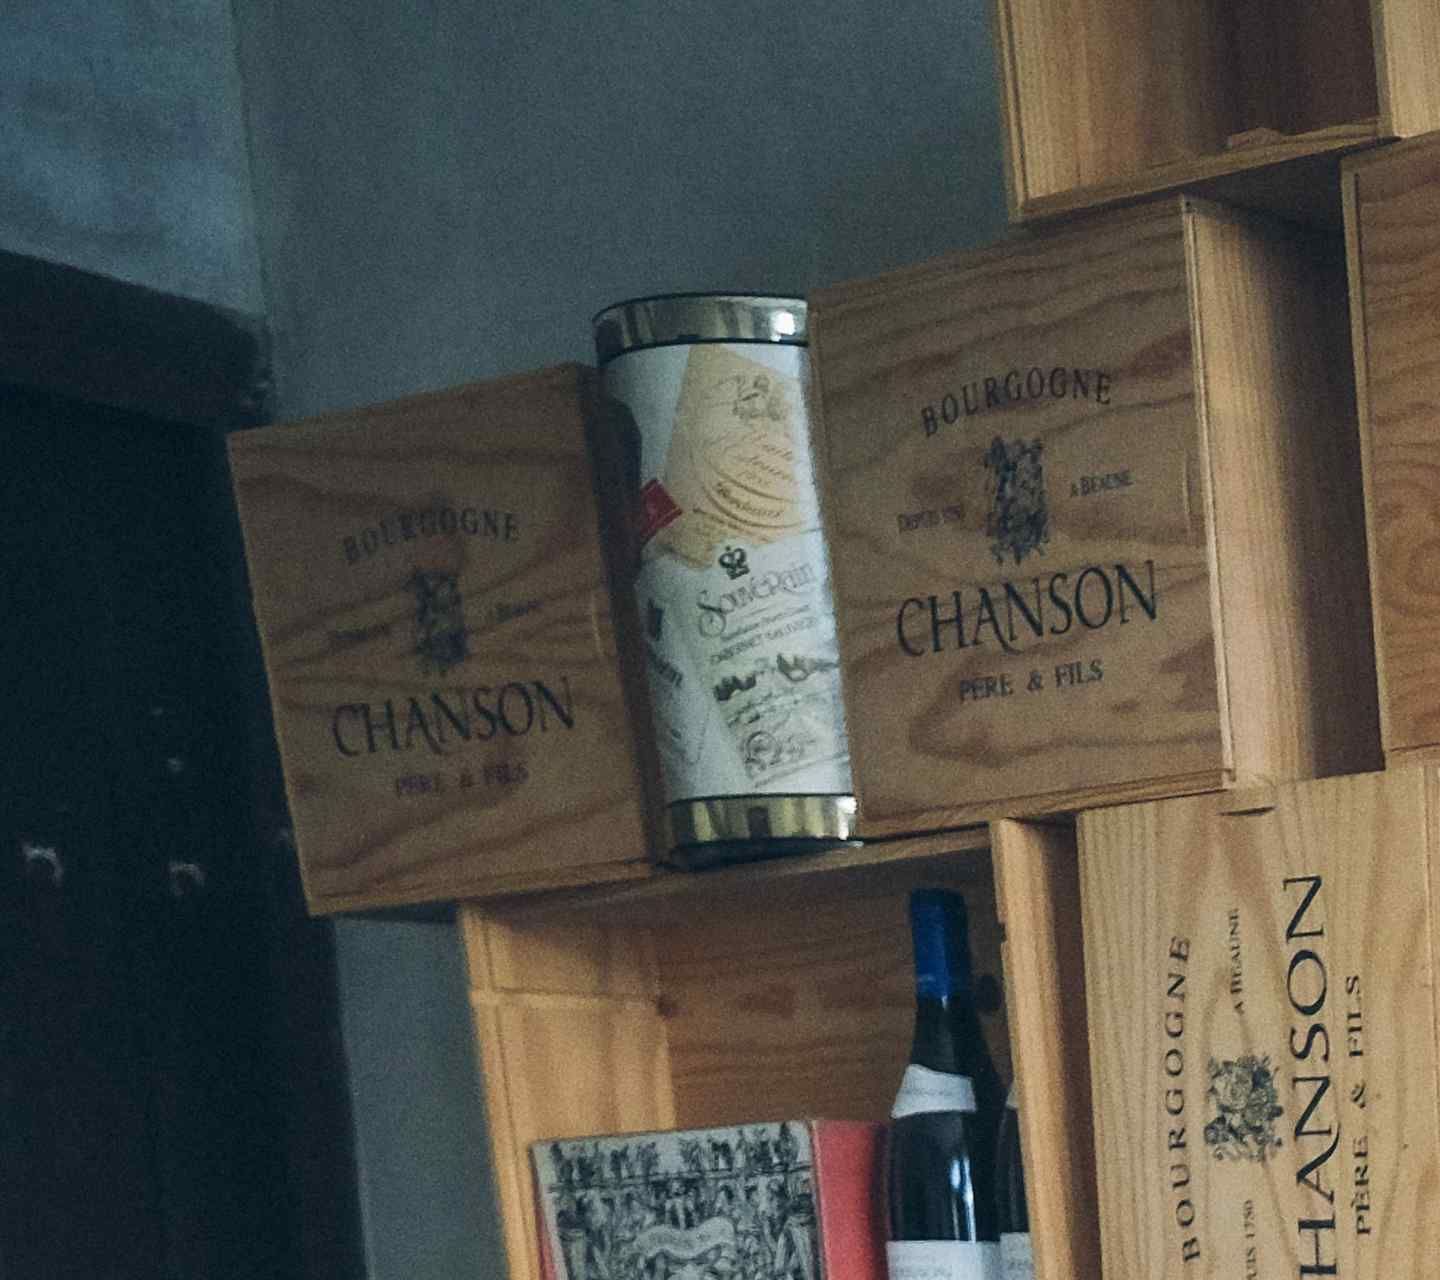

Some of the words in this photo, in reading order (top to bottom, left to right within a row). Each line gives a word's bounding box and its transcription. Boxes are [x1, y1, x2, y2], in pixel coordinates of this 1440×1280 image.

[920, 368, 1113, 438] BOURGOGNE
[895, 560, 1160, 658] CHANSON
[1054, 658, 1105, 688] FILS
[332, 678, 577, 758] CHANSON
[1346, 974, 1364, 1058] FILS
[1164, 934, 1201, 1263] BOURGOGNE
